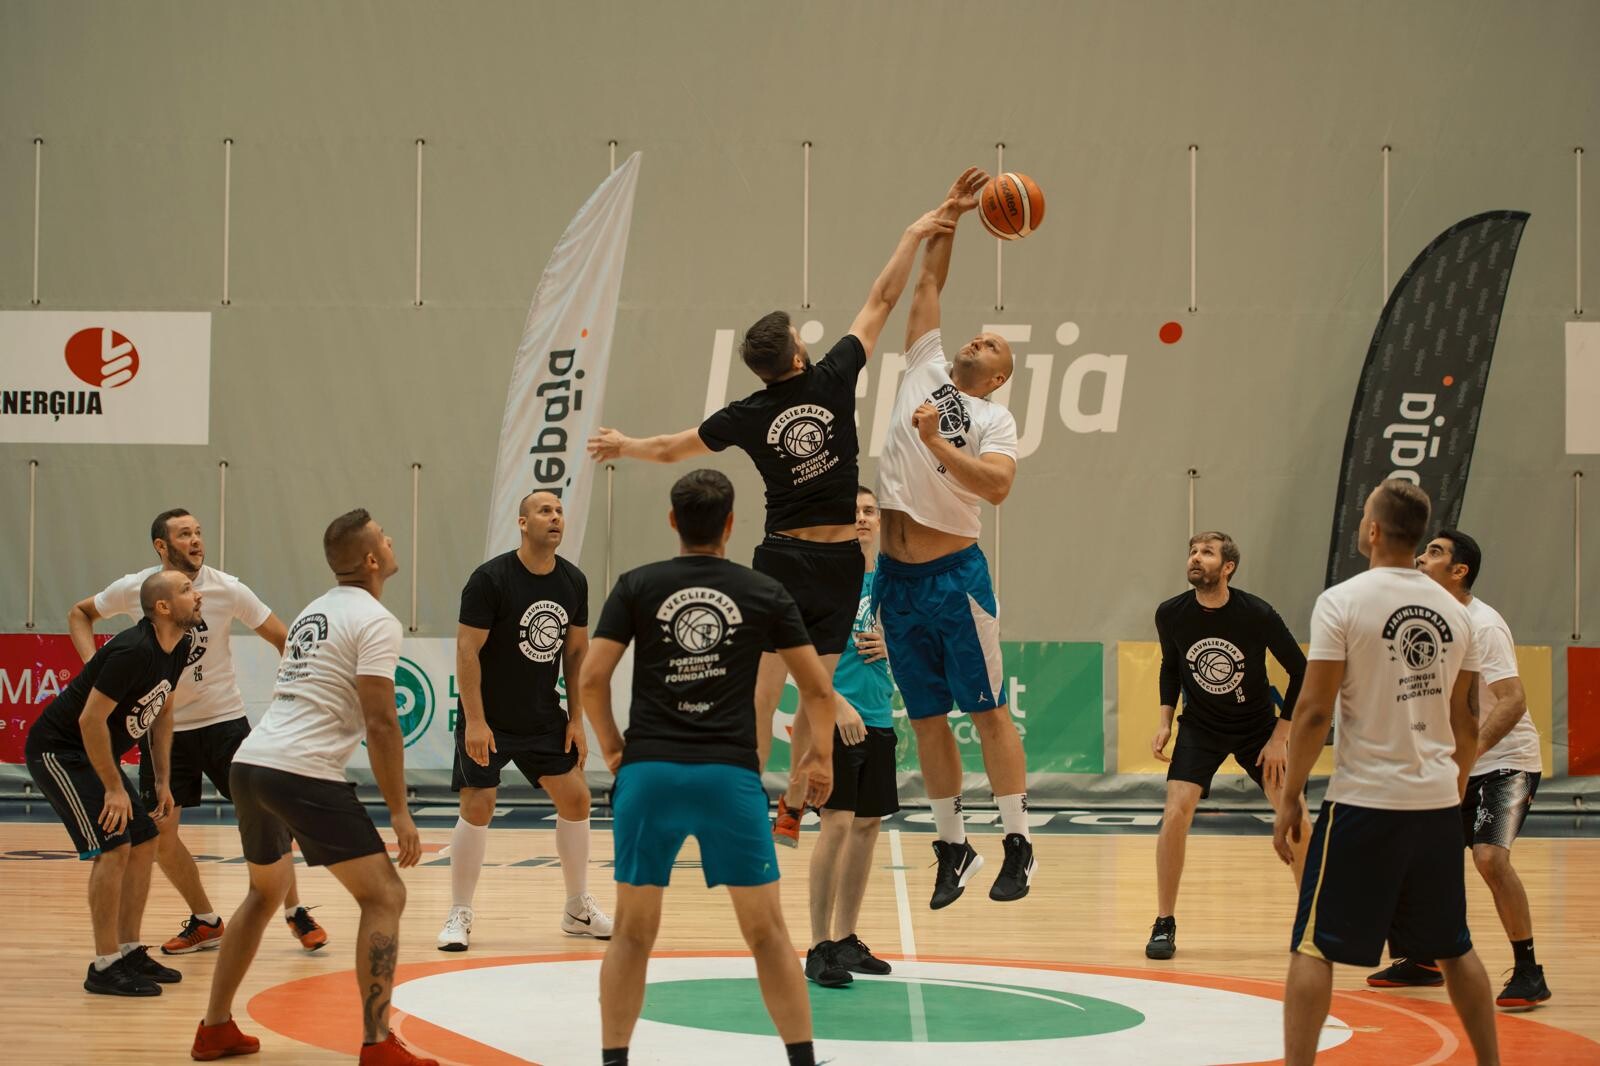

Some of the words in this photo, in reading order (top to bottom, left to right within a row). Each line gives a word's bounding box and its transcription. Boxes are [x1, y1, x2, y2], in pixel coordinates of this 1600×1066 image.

[0, 391, 103, 421] NERĢIJA
[793, 456, 840, 485] FOUNDATION
[800, 458, 827, 476] FAMILY
[665, 667, 727, 683] FOUNDATION
[678, 663, 713, 673] FAMILY
